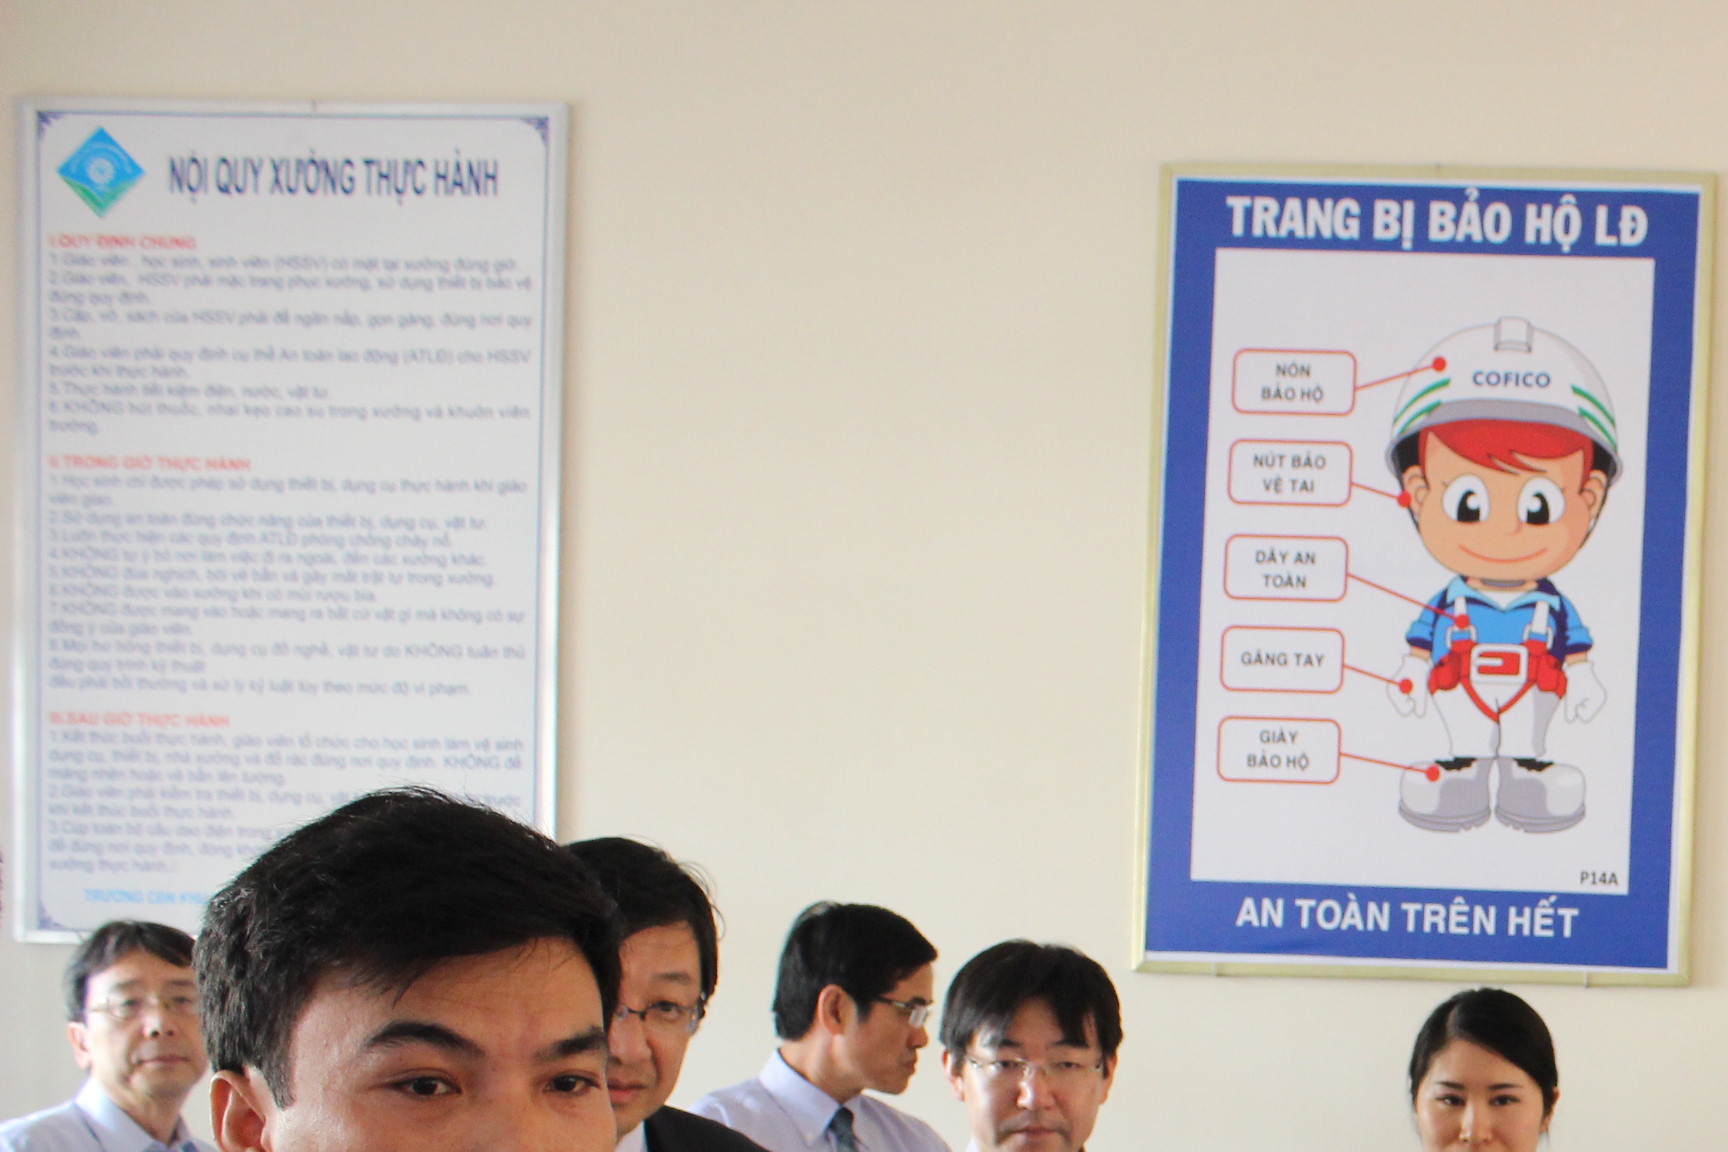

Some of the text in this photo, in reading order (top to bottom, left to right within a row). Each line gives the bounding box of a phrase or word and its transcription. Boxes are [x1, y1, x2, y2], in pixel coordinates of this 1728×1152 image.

[168, 151, 208, 203] NỘI
[215, 156, 264, 195] QUY
[364, 158, 427, 207] THỰC
[434, 148, 500, 198] HÀNH
[1226, 188, 1648, 252] TRANG BỊ BẢO HỘ LĐ
[1275, 361, 1312, 380] NÓN
[1471, 368, 1552, 389] COFICO
[1262, 382, 1325, 405] BẢO HỘ
[1253, 450, 1326, 470] NÚT BẢO
[1263, 476, 1315, 495] VỆ TAI
[1256, 548, 1316, 566] DÂY AN
[1263, 571, 1307, 590] TOÀN
[1241, 648, 1325, 668] GĂNG TAY
[1246, 751, 1310, 772] BẢO HỘ
[1579, 870, 1619, 887] P14A
[1236, 892, 1579, 938] AN TOÀN TRÊN HẾT
